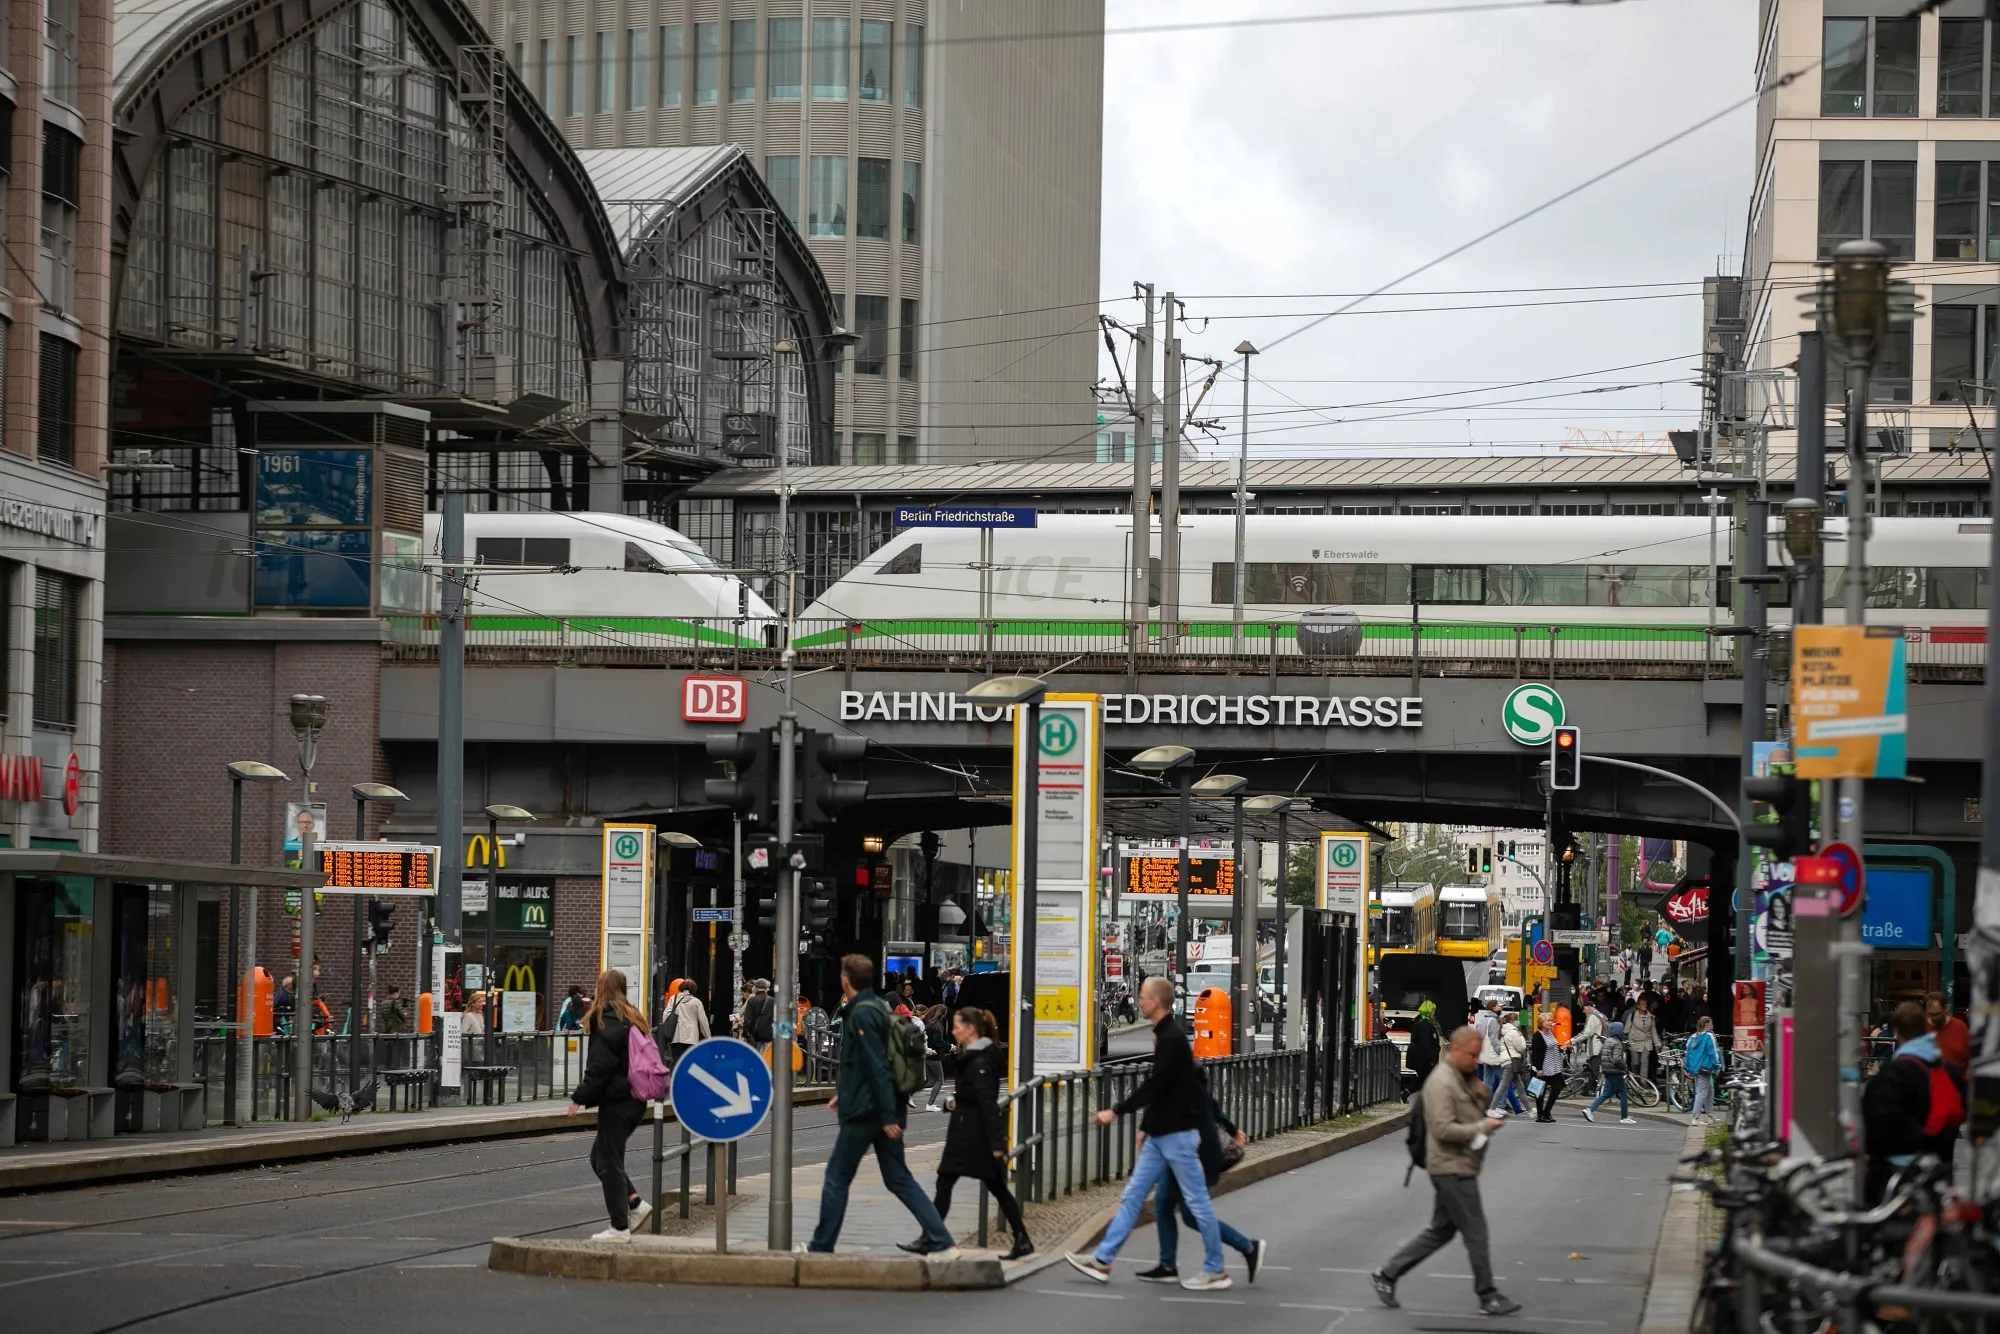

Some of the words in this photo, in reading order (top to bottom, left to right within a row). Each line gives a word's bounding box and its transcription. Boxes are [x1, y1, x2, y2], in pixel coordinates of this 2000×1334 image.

[263, 455, 300, 473] 1961
[900, 510, 932, 521] Berlin
[935, 511, 1015, 522] Friedrichstraße
[1324, 550, 1379, 559] Eberswalde
[994, 555, 1091, 601] ICE
[1905, 573, 1917, 588] 2
[692, 684, 737, 714] DB
[1103, 693, 1423, 727] EDRICHSTRASSE
[1512, 689, 1555, 740] S
[1191, 875, 1203, 883] Bus
[499, 886, 550, 899] McDALD'S.
[1557, 932, 1597, 941] Georgenstraße
[1861, 922, 1903, 938] traße
